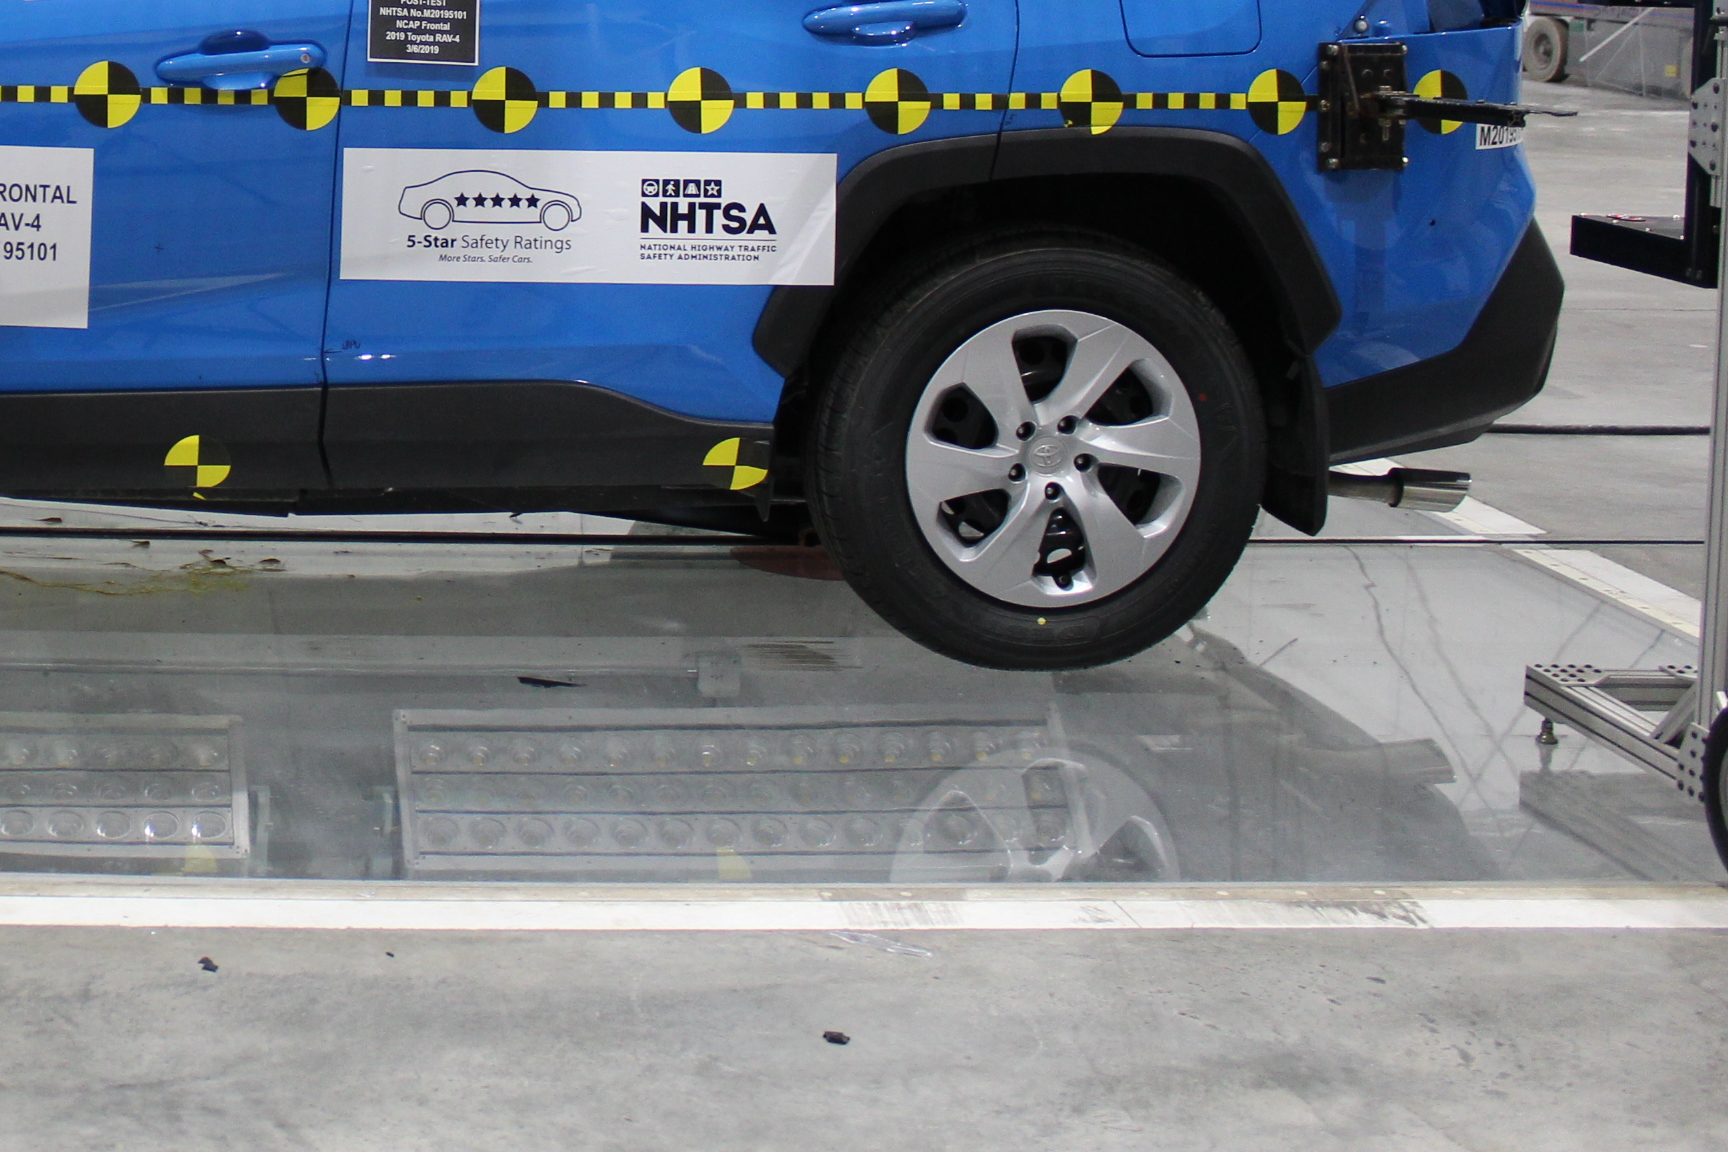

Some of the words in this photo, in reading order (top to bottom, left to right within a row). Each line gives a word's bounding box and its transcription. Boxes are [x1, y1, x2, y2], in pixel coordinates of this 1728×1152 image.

[380, 7, 408, 16] NHTSA
[410, 9, 466, 19] No.M20195101
[396, 20, 420, 29] NCAP
[422, 21, 450, 30] Frontal
[386, 31, 405, 40] 2019
[407, 32, 433, 43] Toyota
[436, 34, 460, 42] RAV-4
[406, 44, 439, 54] 3/6/2019
[641, 201, 777, 235] NHTSA
[407, 235, 456, 248] 5-Star
[461, 235, 509, 252] Safety
[514, 236, 571, 253] Ratings
[640, 243, 687, 252] NATIONAL
[691, 244, 734, 252] HIGHWAY
[738, 244, 776, 253] TRAFFIC
[439, 253, 461, 263] More
[463, 253, 485, 263] Stars.
[488, 254, 510, 263] Safer
[512, 254, 532, 264] Cars.
[640, 252, 674, 261] SAFETY
[678, 253, 759, 262] ADMINISTRATION
